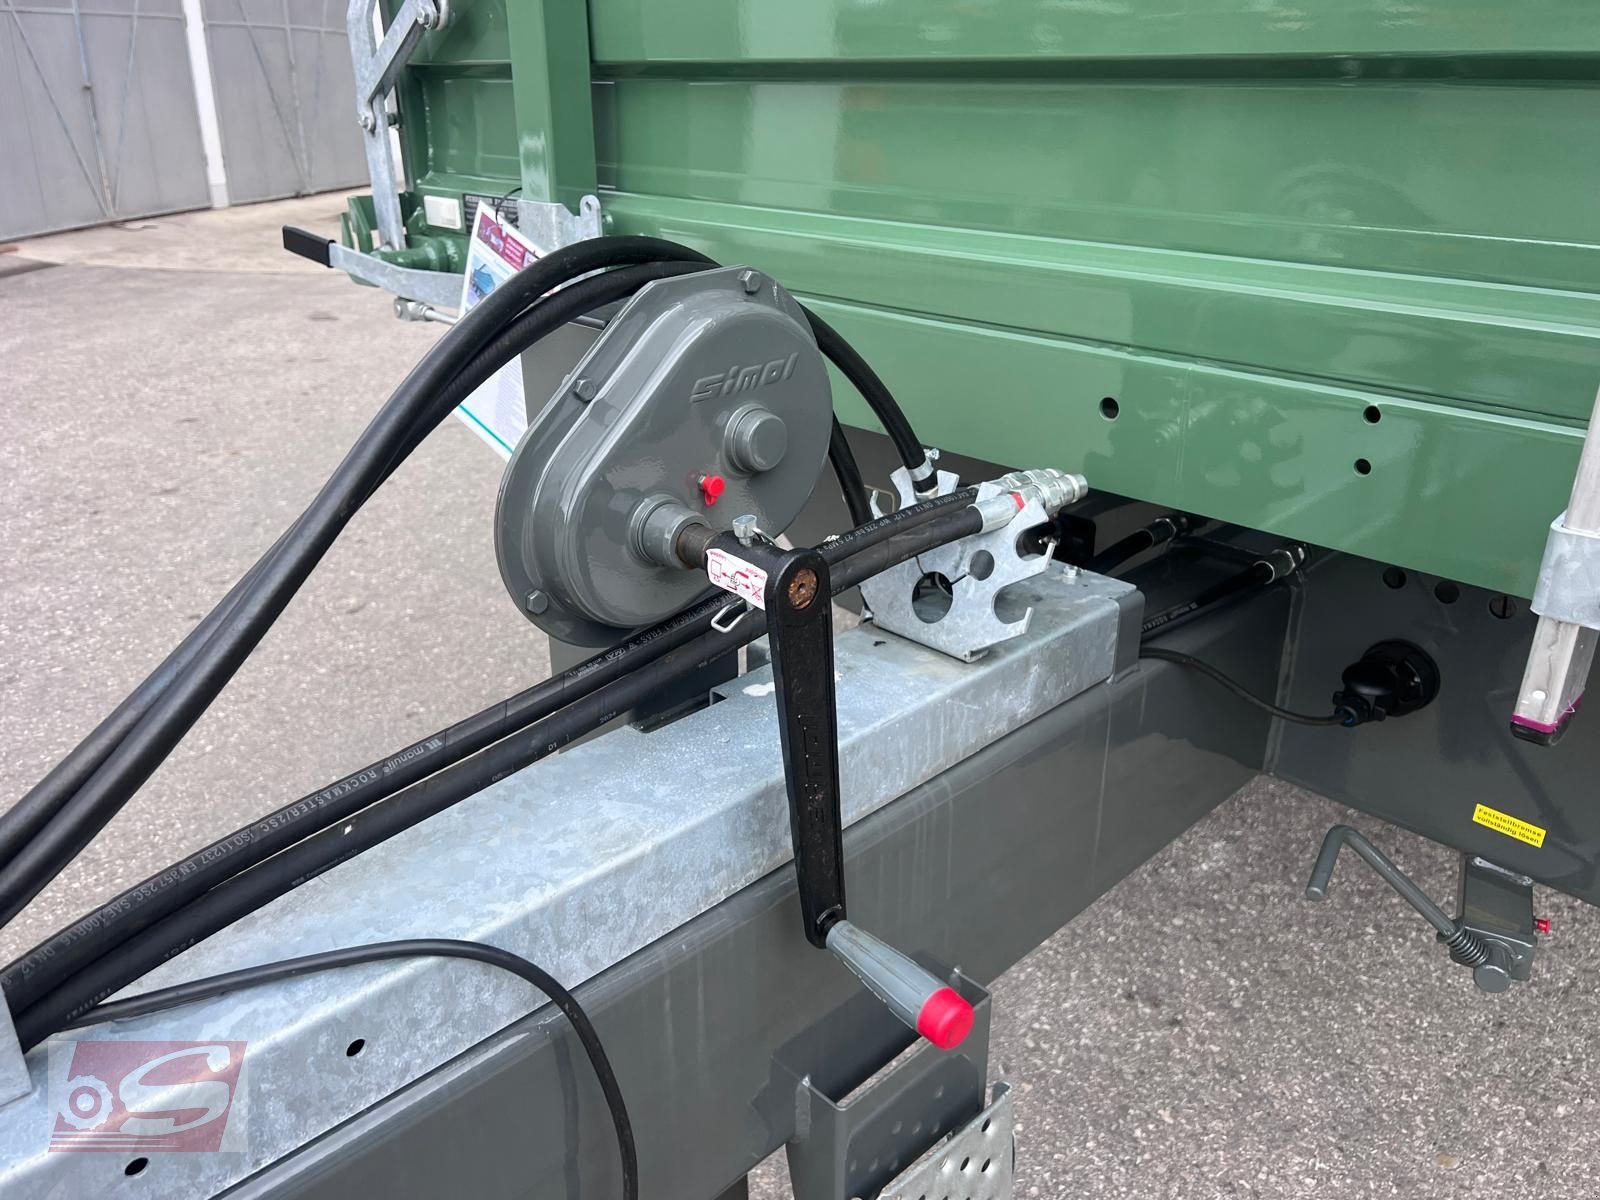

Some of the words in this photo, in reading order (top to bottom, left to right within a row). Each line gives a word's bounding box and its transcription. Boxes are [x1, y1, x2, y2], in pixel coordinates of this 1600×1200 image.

[257, 767, 378, 833] ROCKMASTER/2SC
[198, 838, 235, 865] 11237
[177, 859, 197, 876] EN
[131, 880, 159, 903] 2SC
[103, 896, 132, 919] SAE
